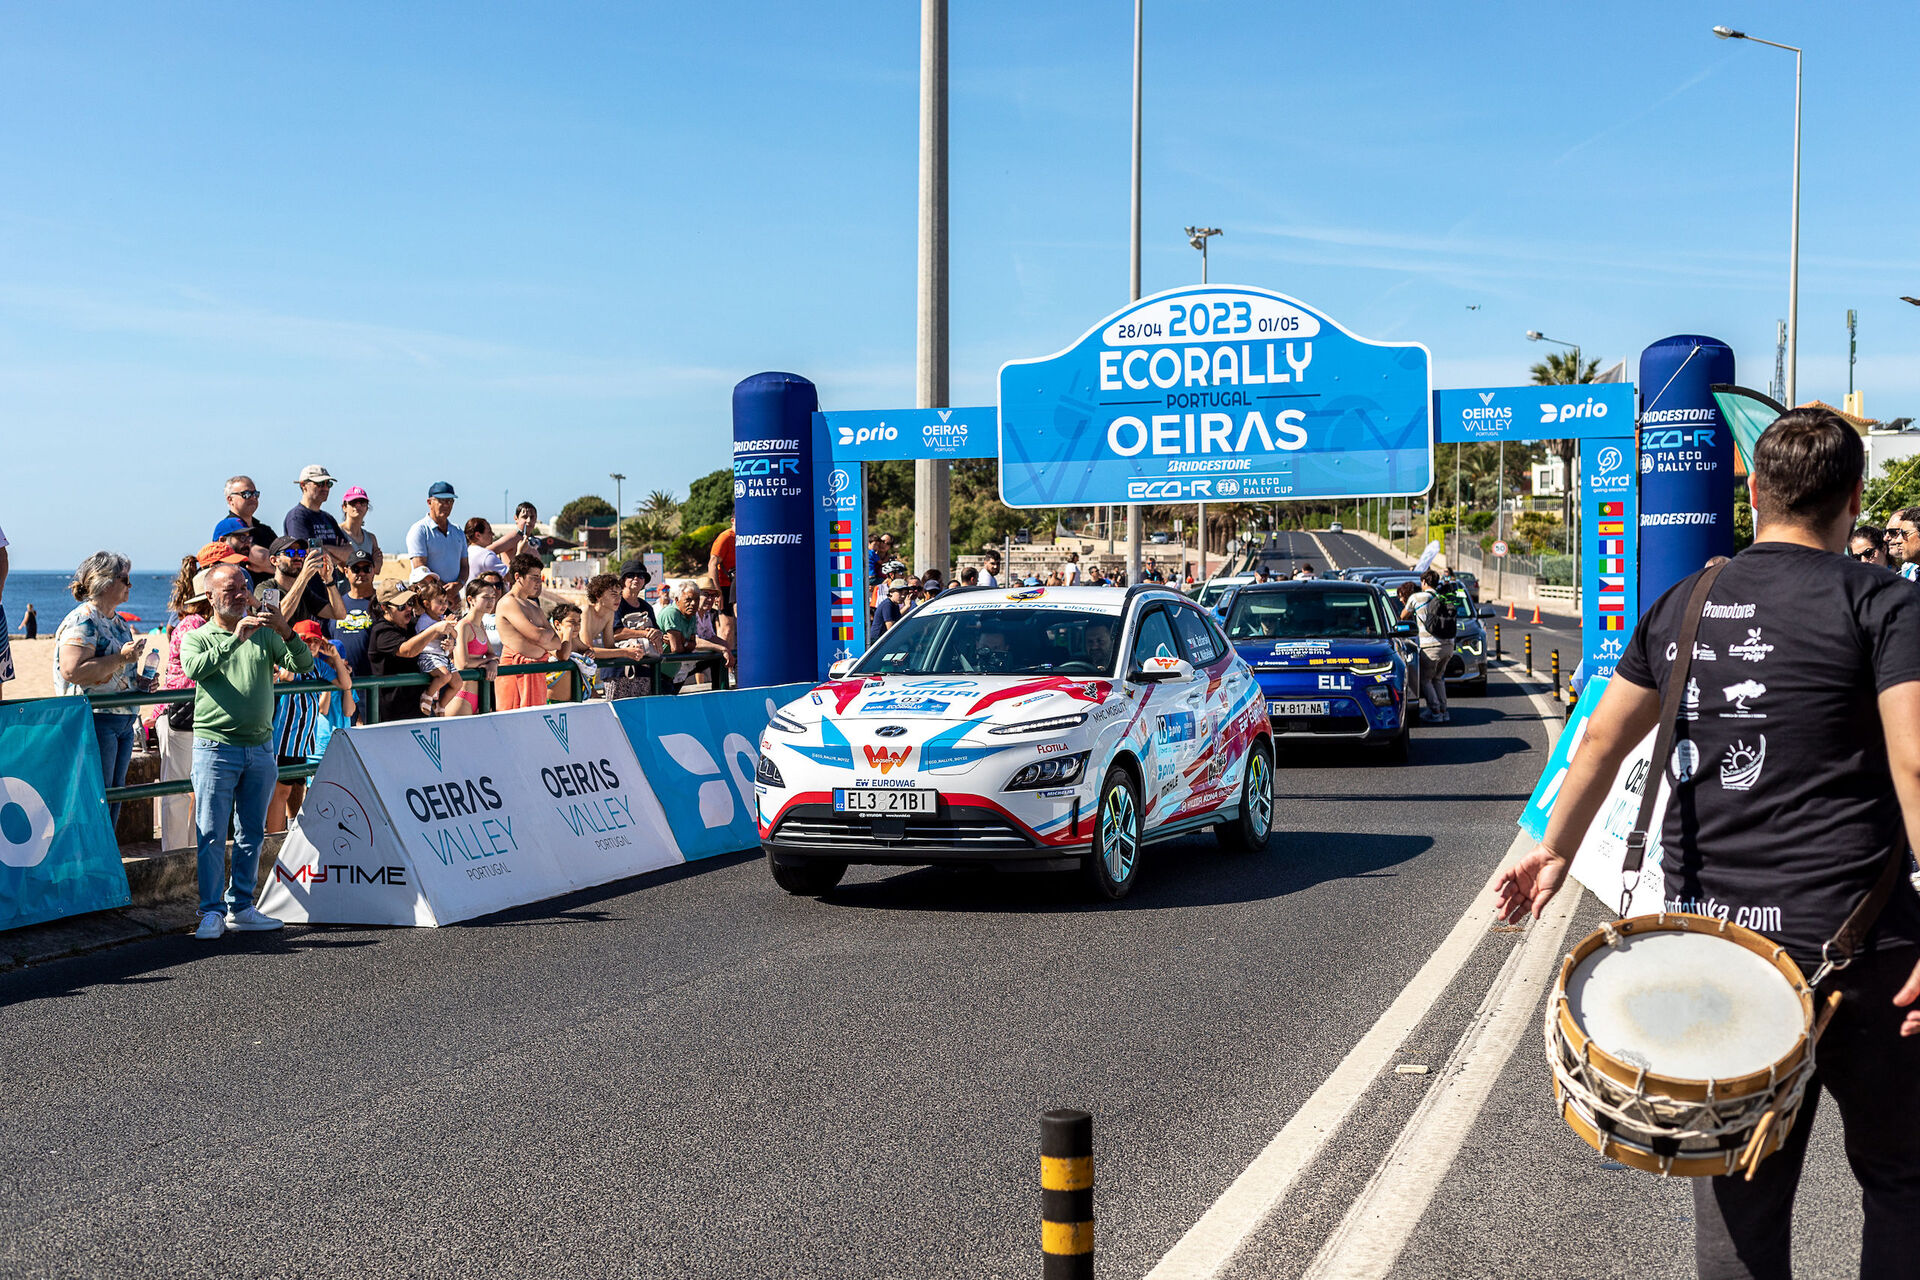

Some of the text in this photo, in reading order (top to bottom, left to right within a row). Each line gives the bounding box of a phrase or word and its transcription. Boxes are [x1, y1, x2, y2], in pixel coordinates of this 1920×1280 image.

[1118, 301, 1299, 338] 28/04 2023 01/05
[1100, 342, 1313, 391] ECORALLY
[1167, 391, 1252, 408] PORTUGAL
[1462, 407, 1512, 419] OEIRAS
[1559, 397, 1608, 423] prio
[922, 424, 968, 435] OEIRAS
[1107, 409, 1308, 456] OEIRAS
[1462, 419, 1512, 431] VALLEY
[855, 422, 898, 445] prio
[922, 436, 968, 447] VALLEY
[1657, 452, 1675, 461] FIA
[1678, 451, 1702, 460] ECO
[1167, 459, 1252, 472] BRIDGESTONE
[1657, 462, 1718, 472] RALLY CUP
[748, 479, 763, 487] FIA
[767, 478, 787, 486] ECO
[1590, 473, 1630, 487] byrd
[749, 487, 802, 497] RALLY CUP
[1243, 486, 1293, 495] RALLY CUP
[822, 494, 856, 507] byrd
[1702, 600, 1756, 619] Promotores
[1318, 674, 1352, 690] ELL
[868, 689, 980, 698] HYUNDAI
[1036, 743, 1069, 754] FLOTILA
[540, 758, 620, 799] OEIRAS
[871, 779, 916, 788] EUROWAG
[405, 776, 503, 823] OEIRAS
[848, 792, 877, 810] EL3
[556, 794, 636, 837] VALLEY
[421, 815, 519, 866] VALLEY
[594, 834, 632, 851] PORTUGAL
[276, 864, 407, 886] MYTIME
[466, 862, 512, 881] PORTUGAL
